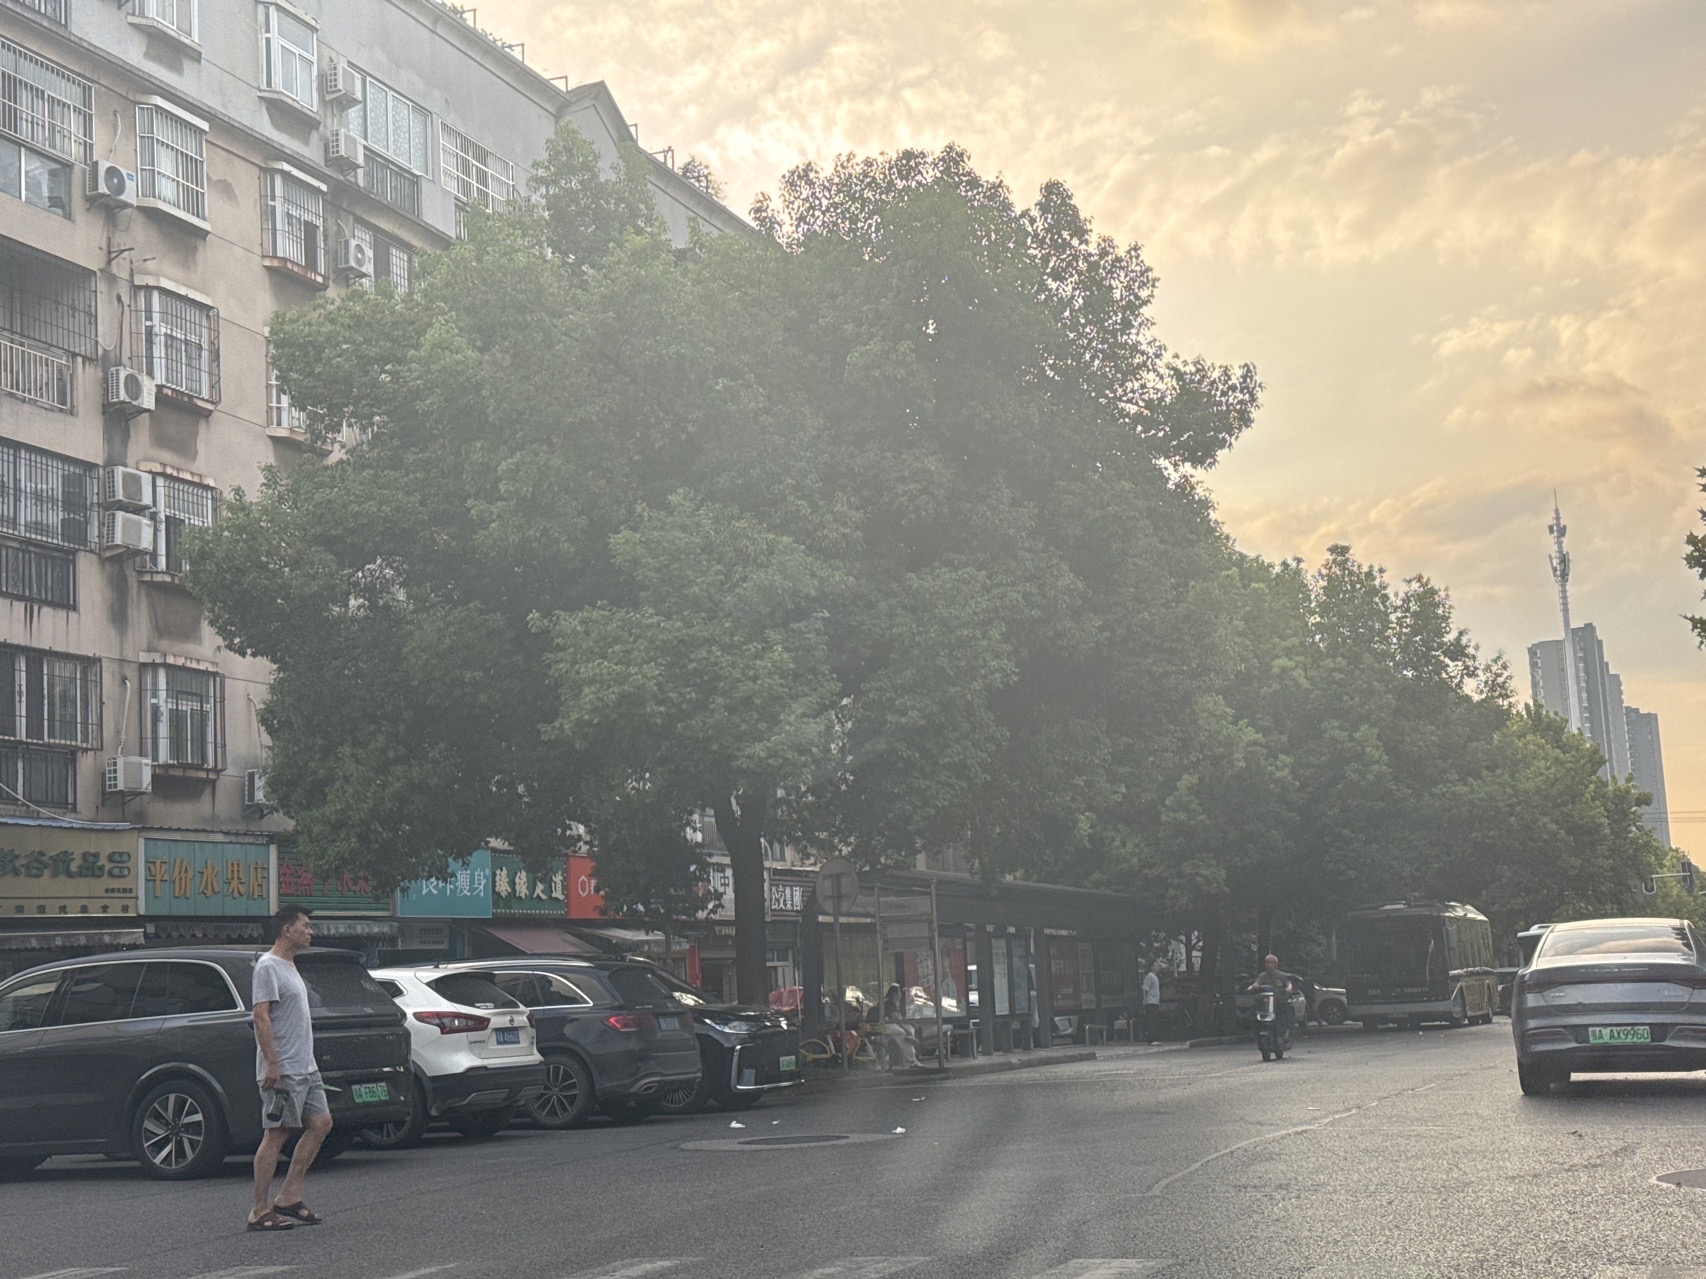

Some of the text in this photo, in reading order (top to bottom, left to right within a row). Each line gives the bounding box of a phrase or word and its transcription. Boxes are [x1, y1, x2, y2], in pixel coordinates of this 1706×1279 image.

[147, 857, 268, 900] 平价水果店
